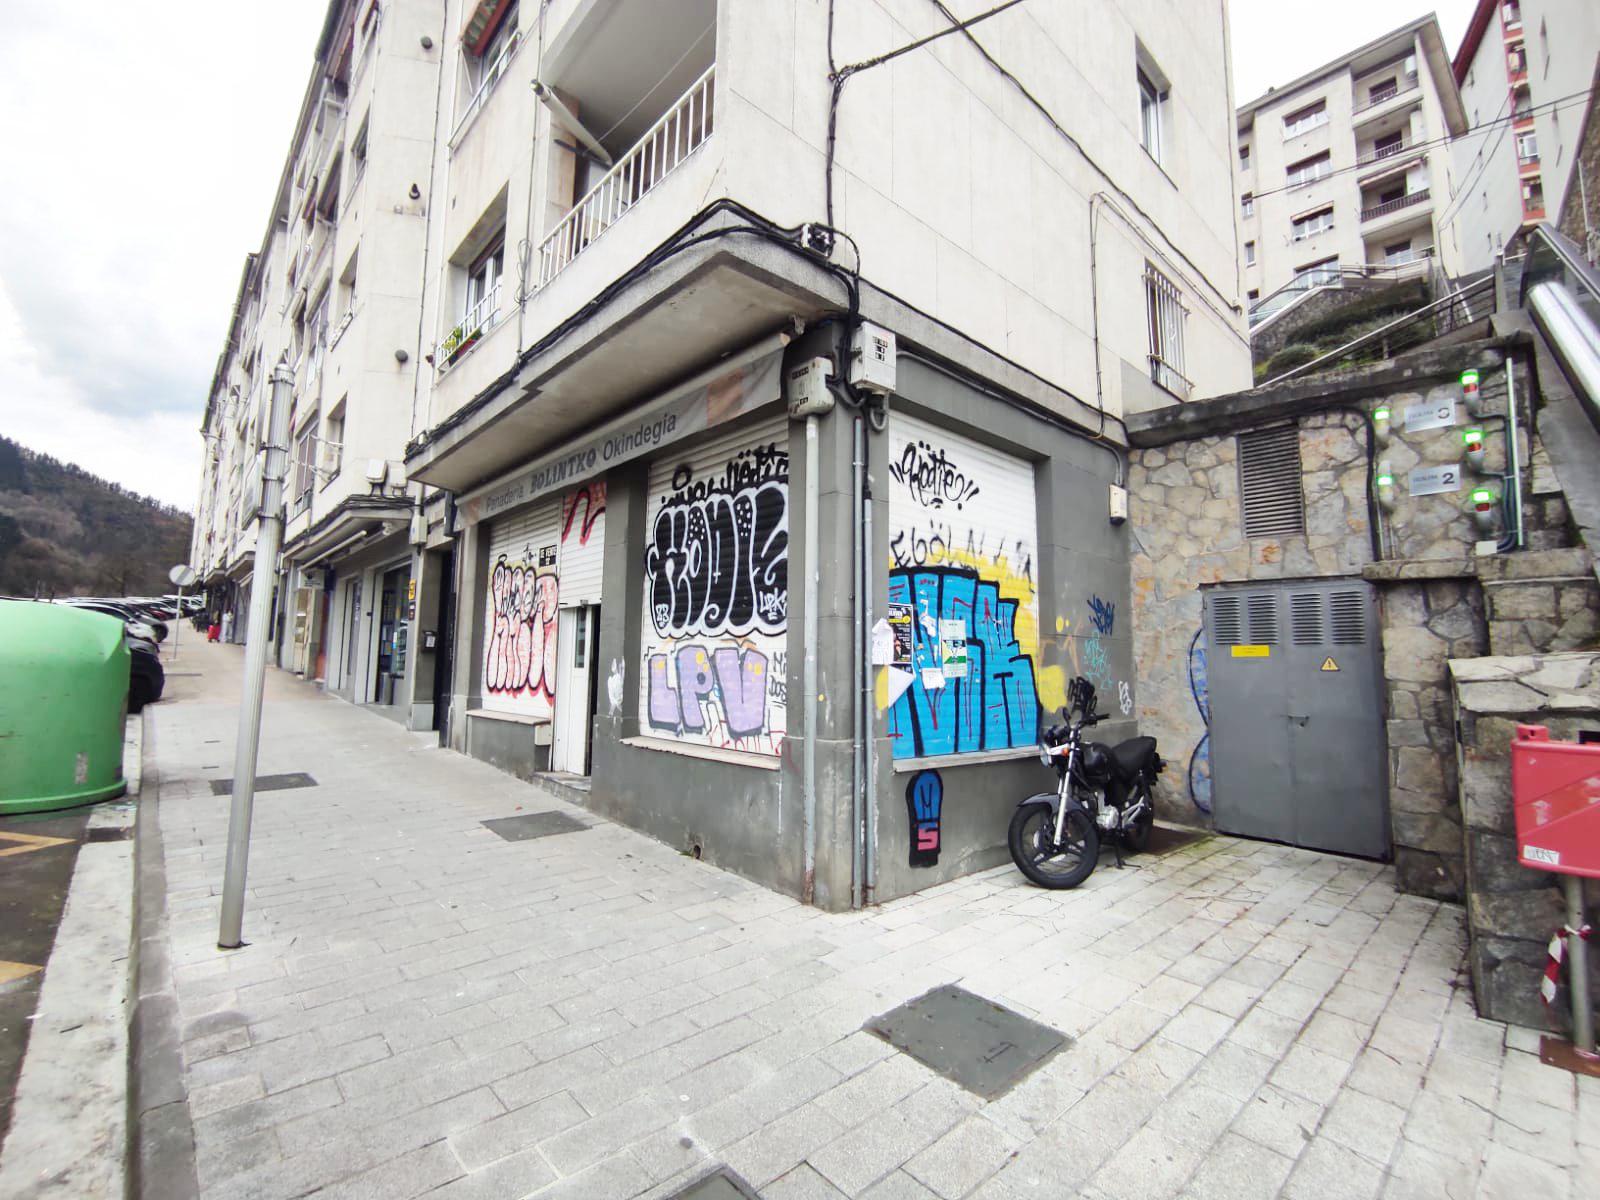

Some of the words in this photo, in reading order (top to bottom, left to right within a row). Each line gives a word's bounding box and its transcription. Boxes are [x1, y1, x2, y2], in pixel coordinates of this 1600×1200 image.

[530, 448, 597, 492] BOLINTXO
[603, 412, 676, 461] Okindegia
[1442, 472, 1455, 484] 2
